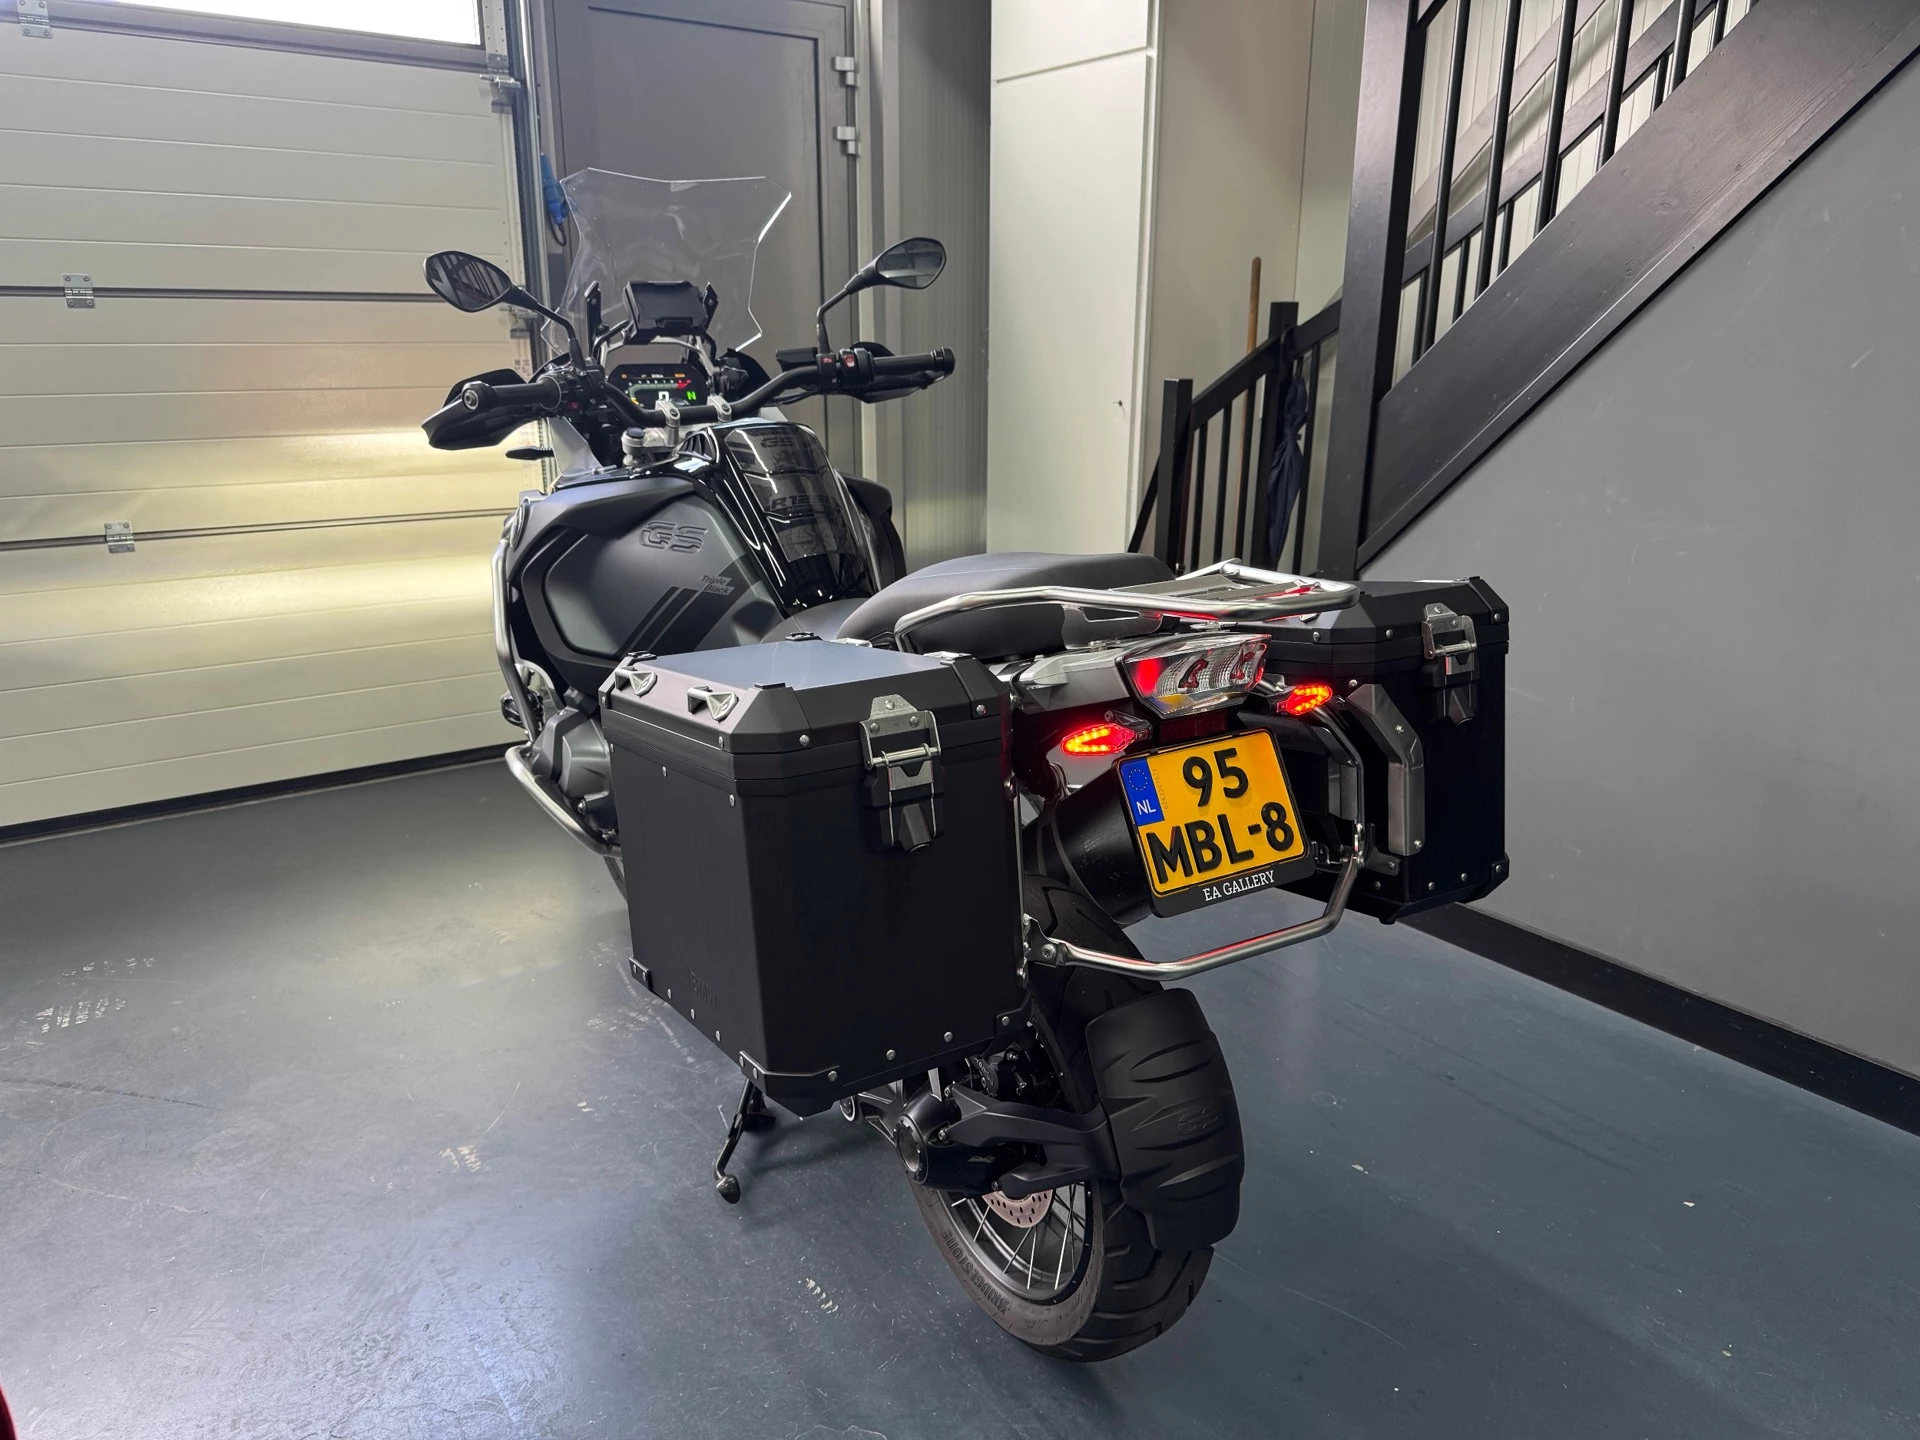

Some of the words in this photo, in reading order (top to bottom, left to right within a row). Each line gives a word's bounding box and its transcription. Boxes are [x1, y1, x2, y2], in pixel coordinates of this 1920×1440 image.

[686, 391, 697, 400] N
[639, 521, 708, 554] GS
[701, 575, 726, 587] Triple
[704, 584, 729, 594] Black
[1182, 747, 1249, 808] 95
[1136, 798, 1157, 815] NL
[1145, 801, 1294, 885] MBL-8
[1203, 887, 1220, 902] EA
[1222, 869, 1275, 895] GALLERY
[942, 1229, 1011, 1315] BRIDGESTONE
